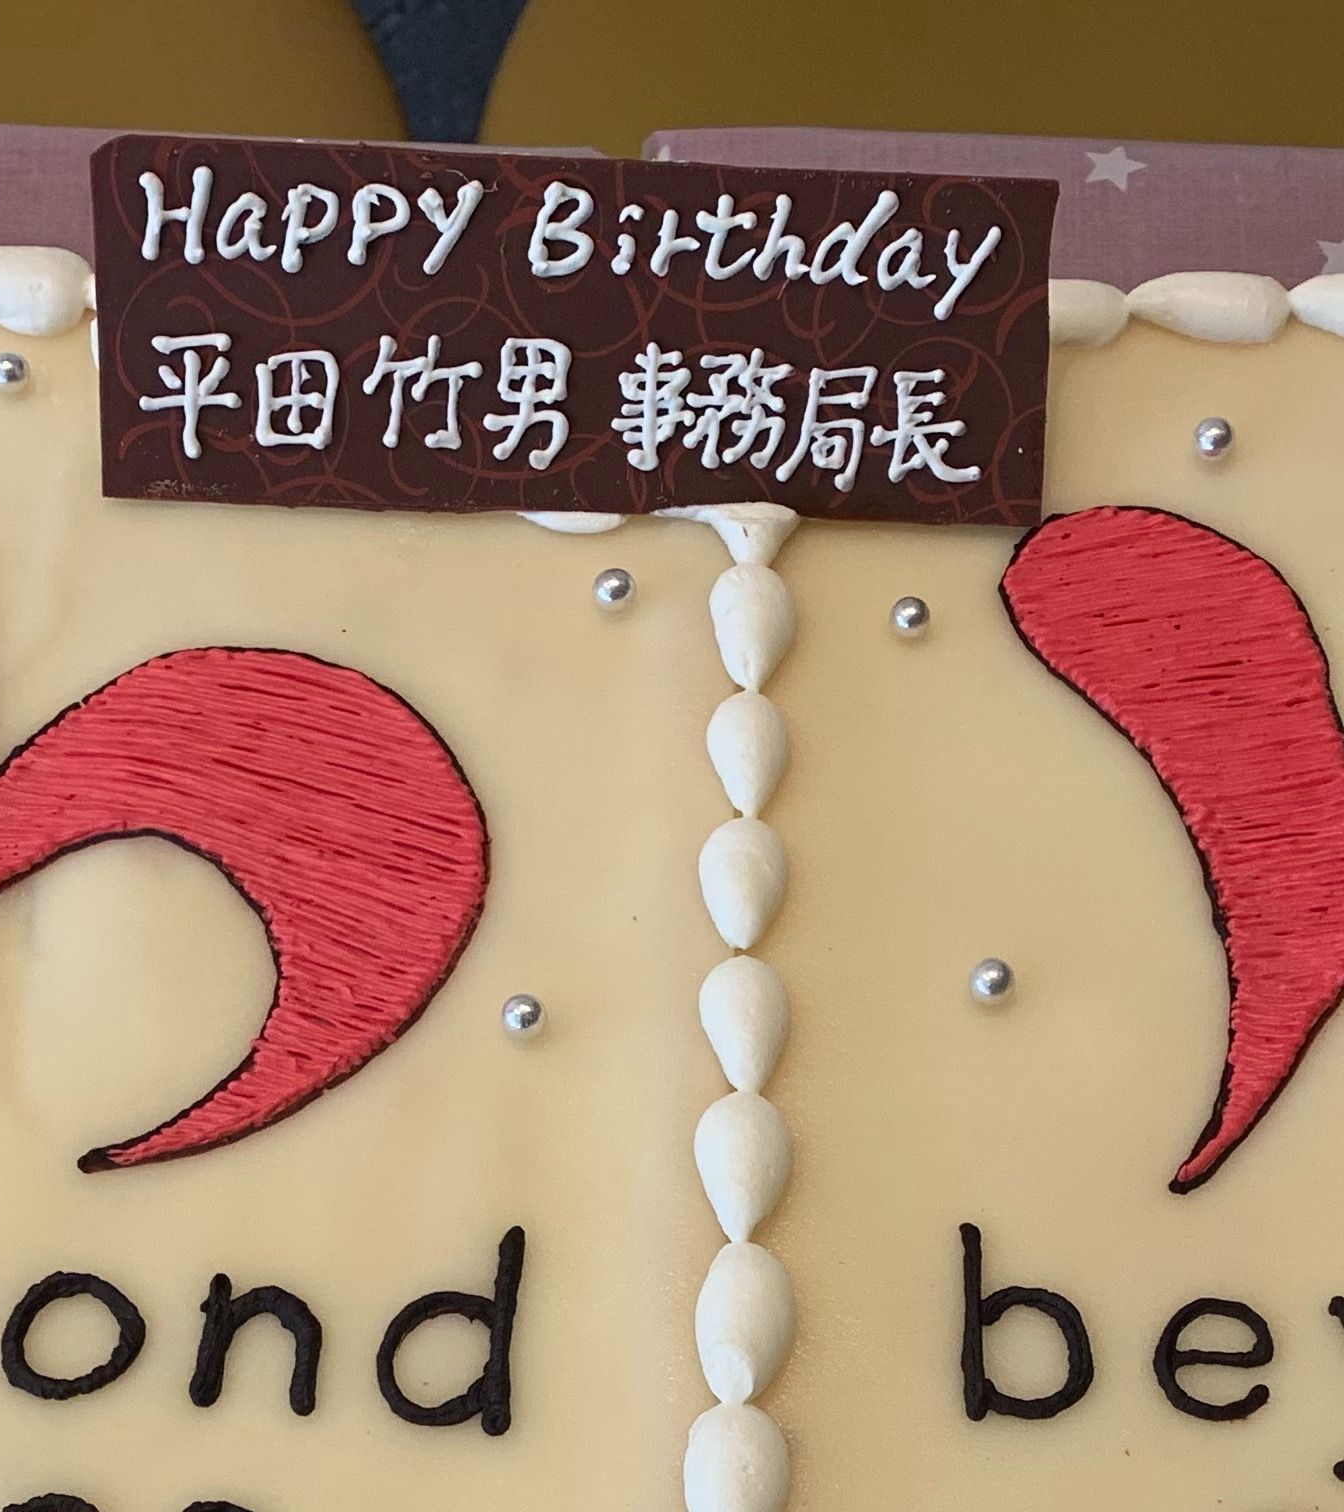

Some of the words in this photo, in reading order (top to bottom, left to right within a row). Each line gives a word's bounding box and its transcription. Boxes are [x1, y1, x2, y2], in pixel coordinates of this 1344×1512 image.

[139, 166, 484, 275] Happy
[526, 180, 1002, 322] Birthday
[139, 333, 574, 470] 平田竹男
[610, 340, 983, 493] 事務局長
